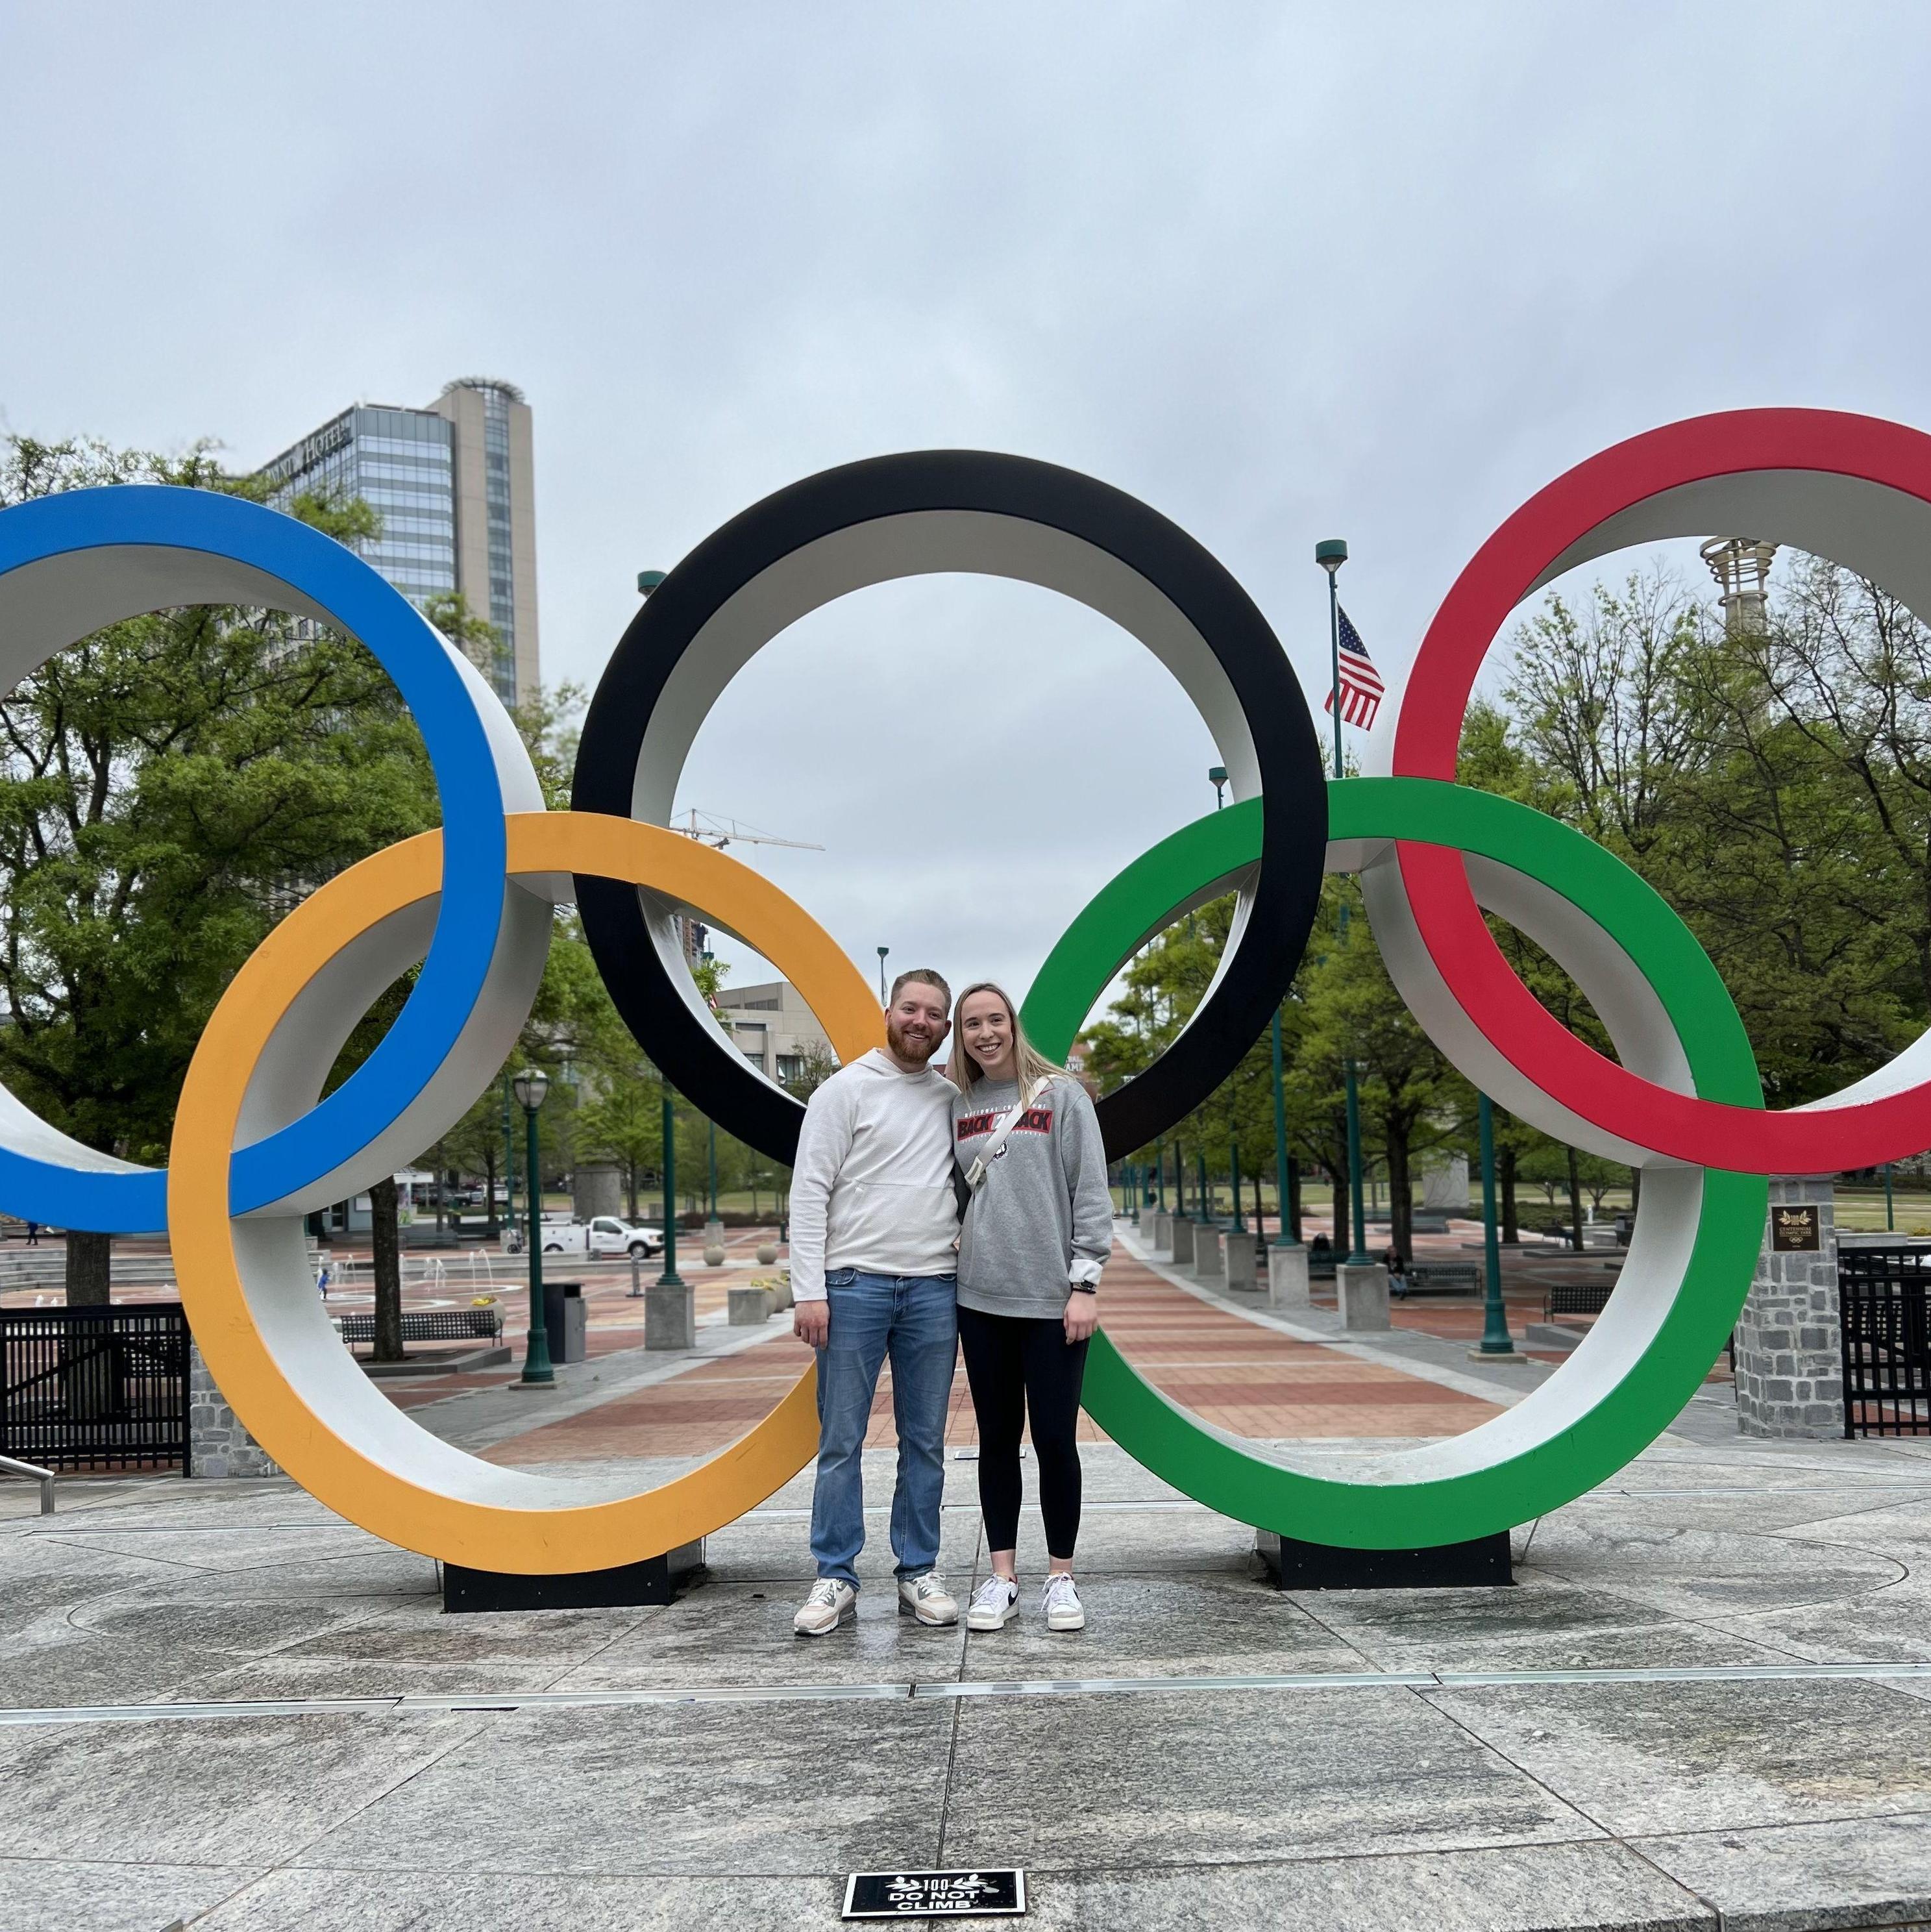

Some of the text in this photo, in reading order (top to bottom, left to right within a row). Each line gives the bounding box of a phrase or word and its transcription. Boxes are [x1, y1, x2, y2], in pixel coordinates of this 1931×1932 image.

[958, 1116, 989, 1139] BACK
[923, 1879, 949, 1892] 100
[889, 1890, 979, 1901] DO NOT
[897, 1900, 971, 1911] CLIMB
